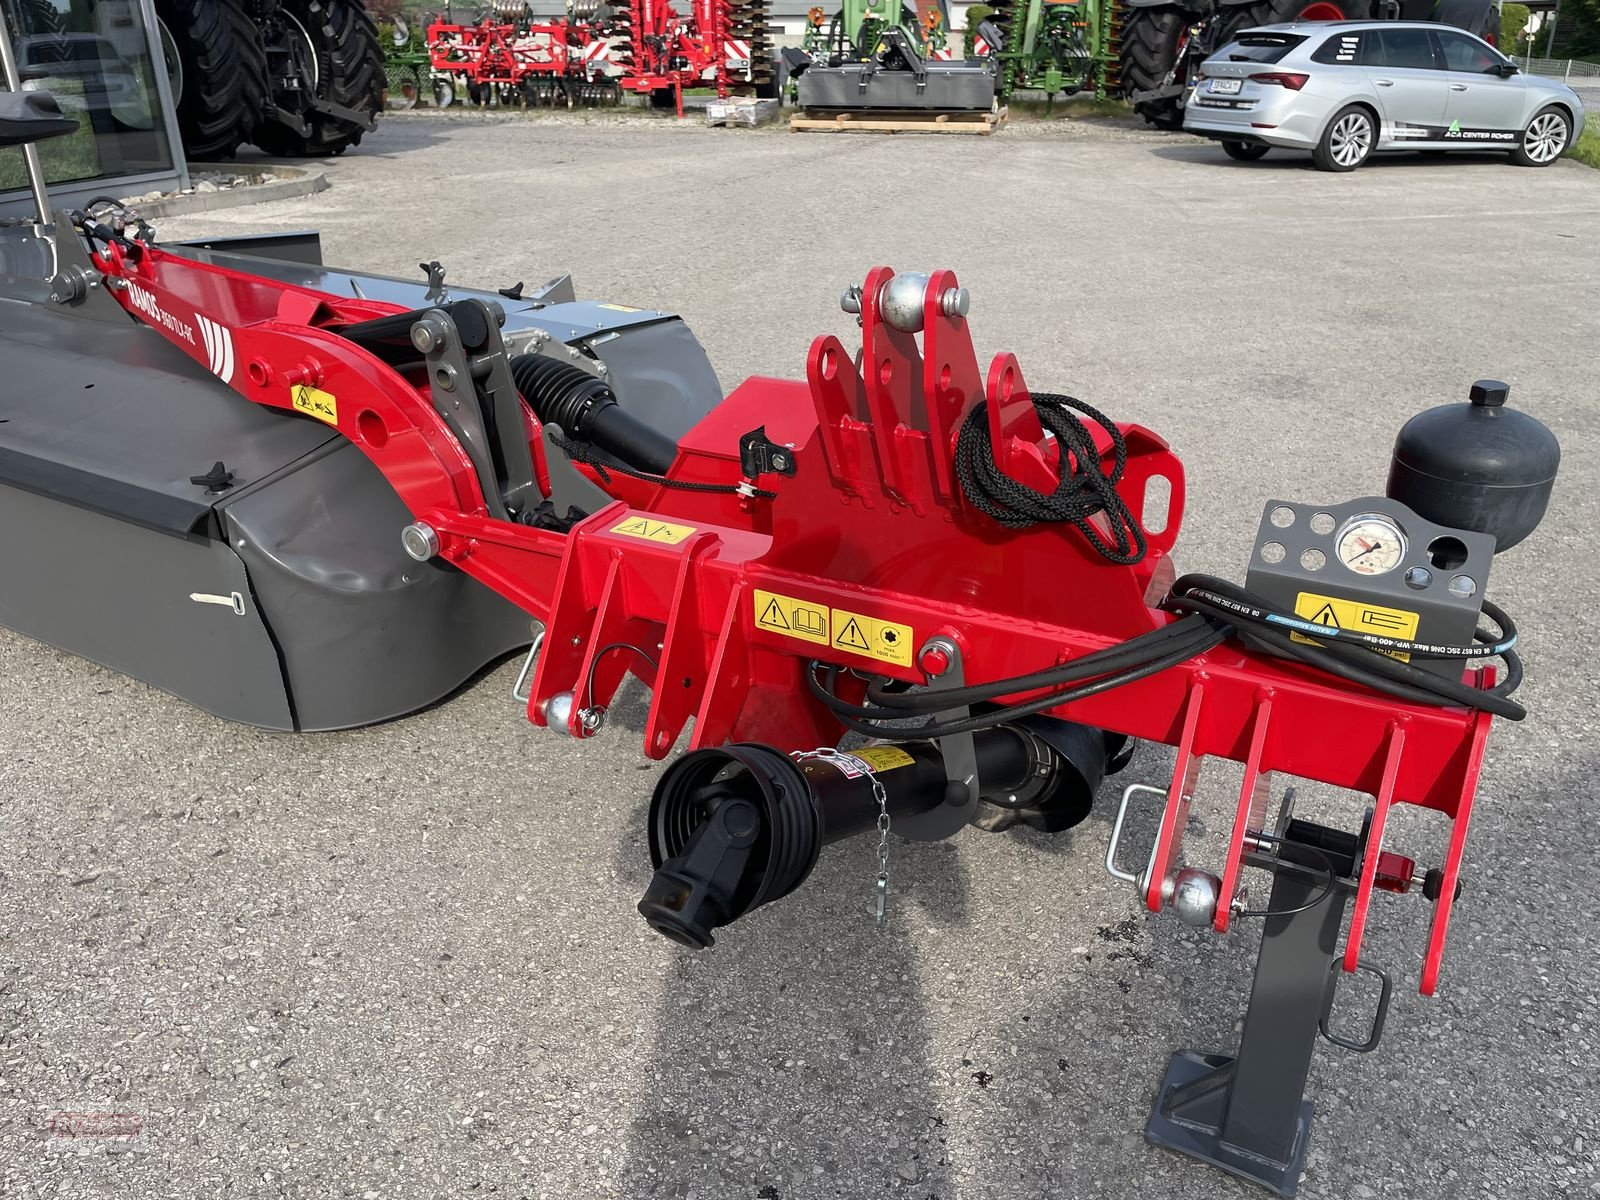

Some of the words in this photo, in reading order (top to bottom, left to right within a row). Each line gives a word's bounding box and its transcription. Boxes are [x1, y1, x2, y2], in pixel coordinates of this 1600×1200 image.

[1462, 131, 1490, 139] CENTER
[126, 279, 161, 322] RAMOS
[1220, 599, 1231, 607] 2SC
[1363, 634, 1378, 645] Bar
[1379, 638, 1394, 646] 400
[1412, 643, 1429, 651] Max.
[1430, 645, 1446, 654] DN6
[1446, 646, 1461, 655] 2SC
